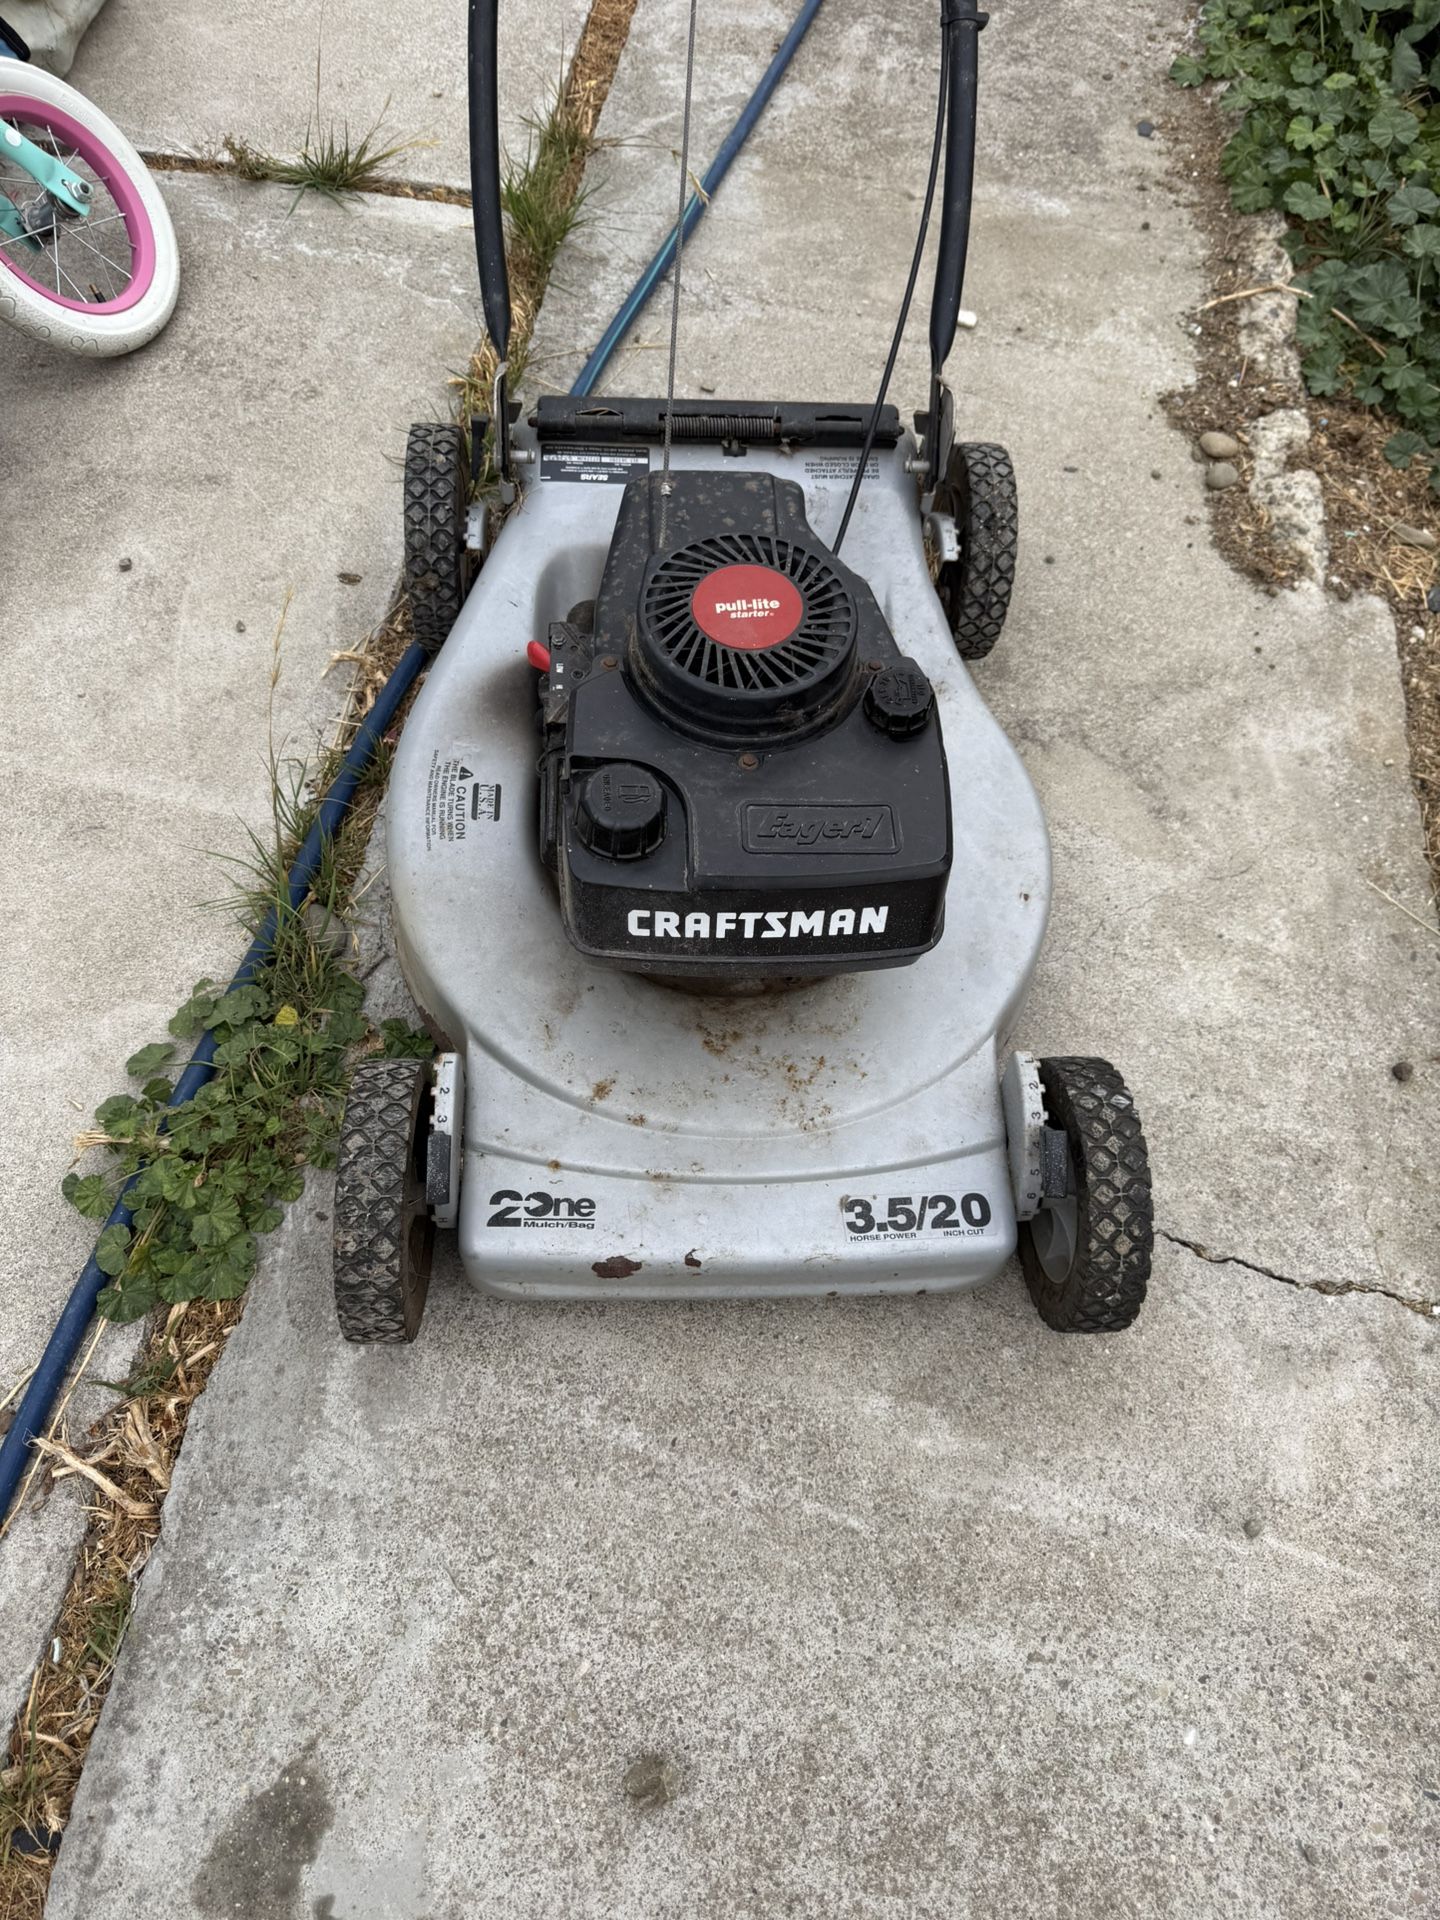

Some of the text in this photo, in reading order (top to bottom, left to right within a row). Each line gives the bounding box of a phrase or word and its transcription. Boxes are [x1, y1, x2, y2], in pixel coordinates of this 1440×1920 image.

[715, 598, 780, 614] pull-lite
[730, 610, 769, 619] starter
[432, 749, 440, 769] SAFETY
[443, 762, 451, 774] THE
[440, 776, 448, 800] ENGINE
[448, 774, 457, 796] BLADE
[478, 784, 489, 819] U.S.A.
[455, 786, 467, 840] CAUTION
[487, 810, 494, 820] IN
[628, 906, 888, 938] CRAFTSMAN
[1029, 1080, 1039, 1089] 2
[437, 1115, 447, 1123] 3
[1032, 1111, 1041, 1120] 3
[844, 1192, 991, 1234] 3.5/20
[523, 1222, 595, 1230] Mulch/Bag
[850, 1234, 881, 1242] HORSE
